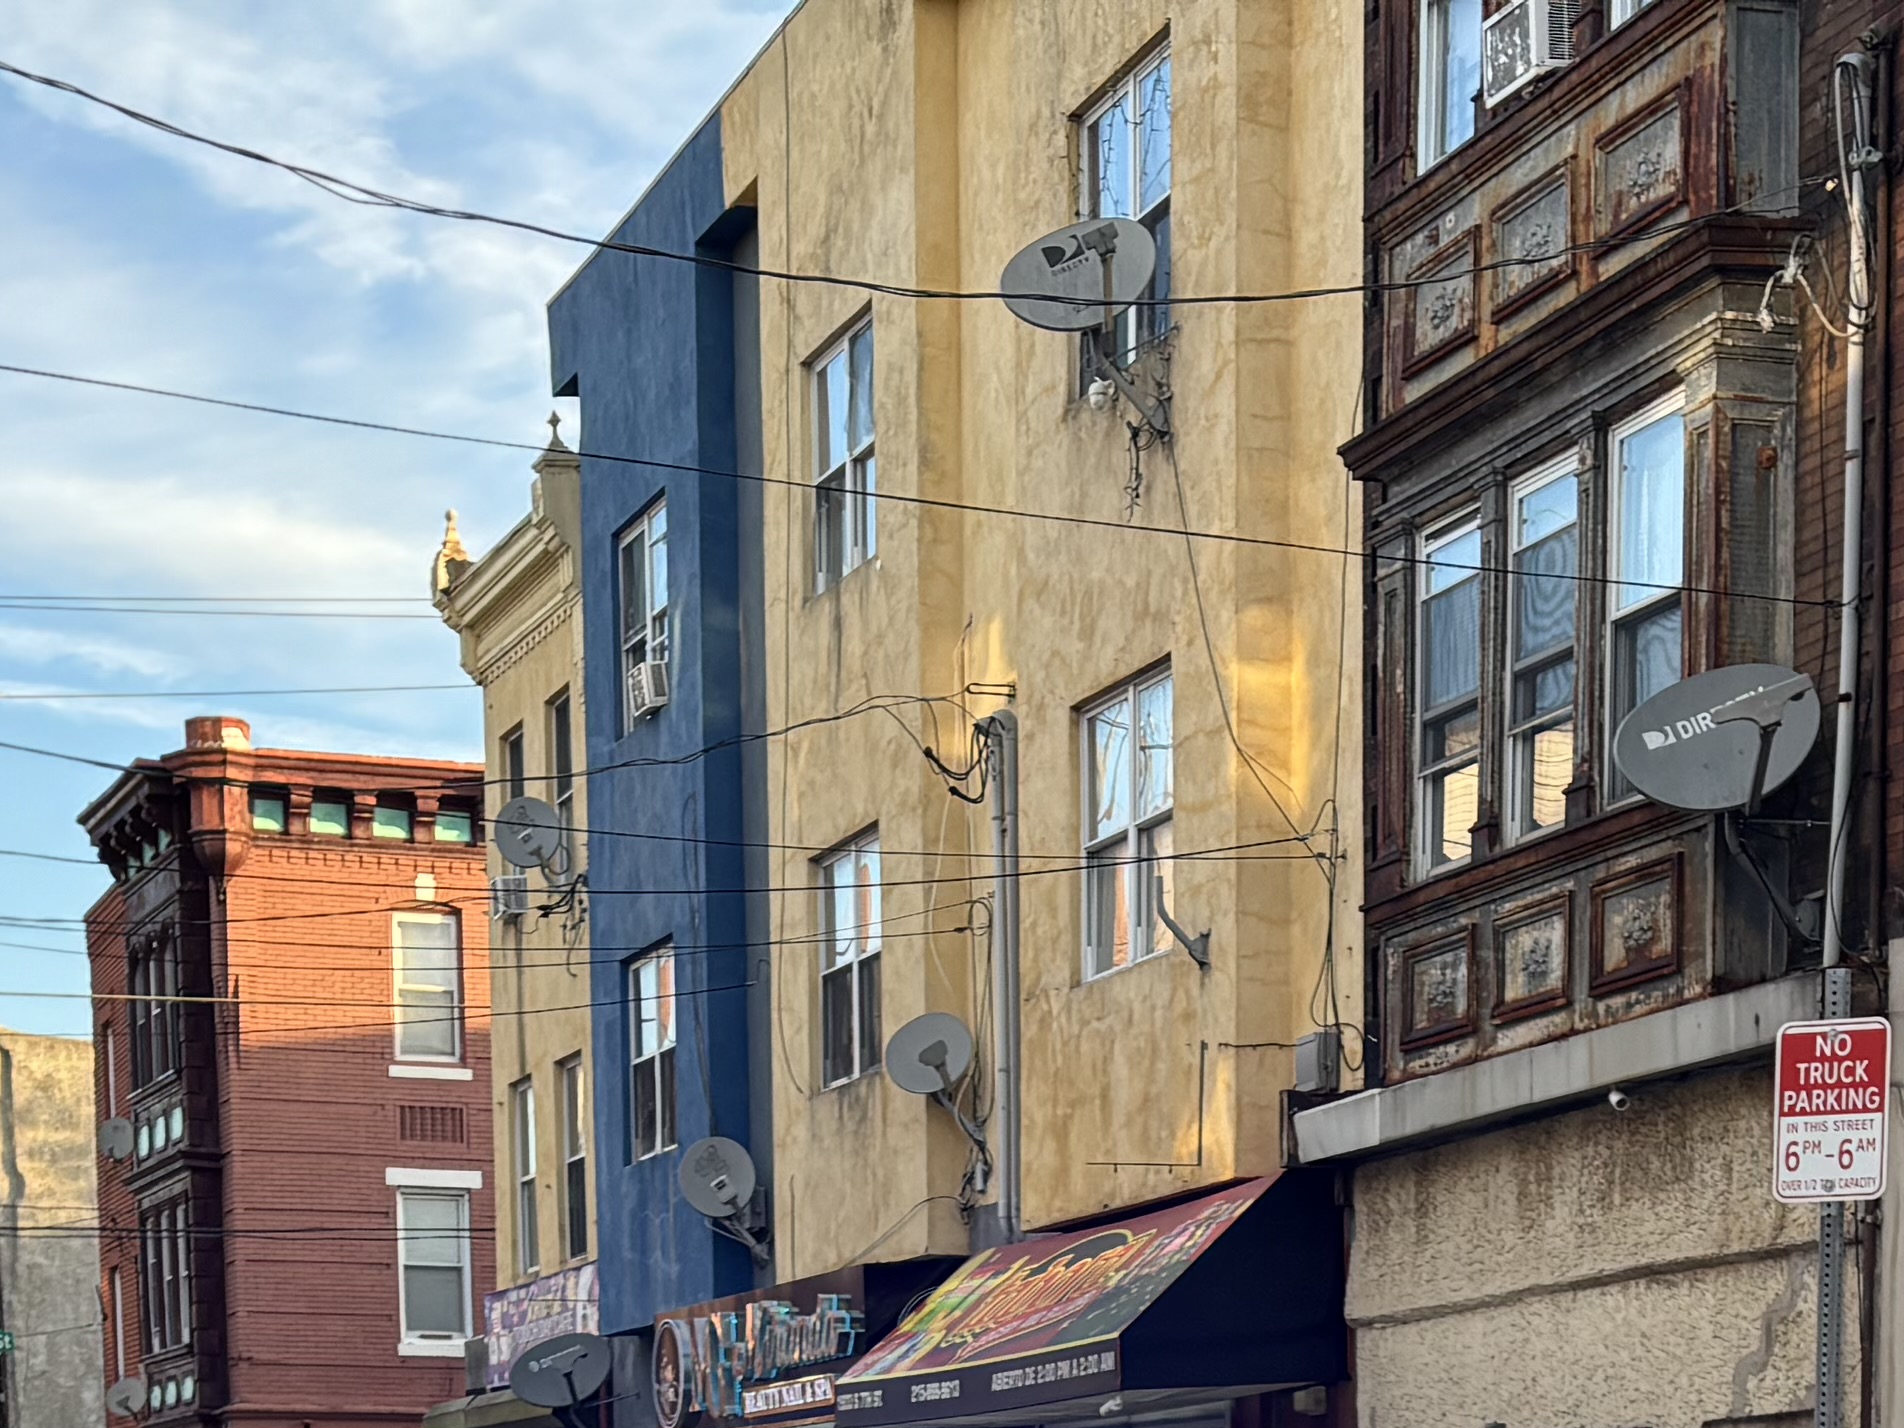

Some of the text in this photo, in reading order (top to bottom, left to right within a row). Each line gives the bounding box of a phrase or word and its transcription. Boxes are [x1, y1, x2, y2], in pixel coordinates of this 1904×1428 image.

[1815, 1034, 1852, 1058] NO
[1796, 1060, 1869, 1086] TRUCK
[1783, 1087, 1880, 1113] PARKING
[1787, 1118, 1875, 1134] IN THIS STREET
[1781, 1179, 1802, 1192] OVER
[1838, 1176, 1877, 1190] CAPACITY
